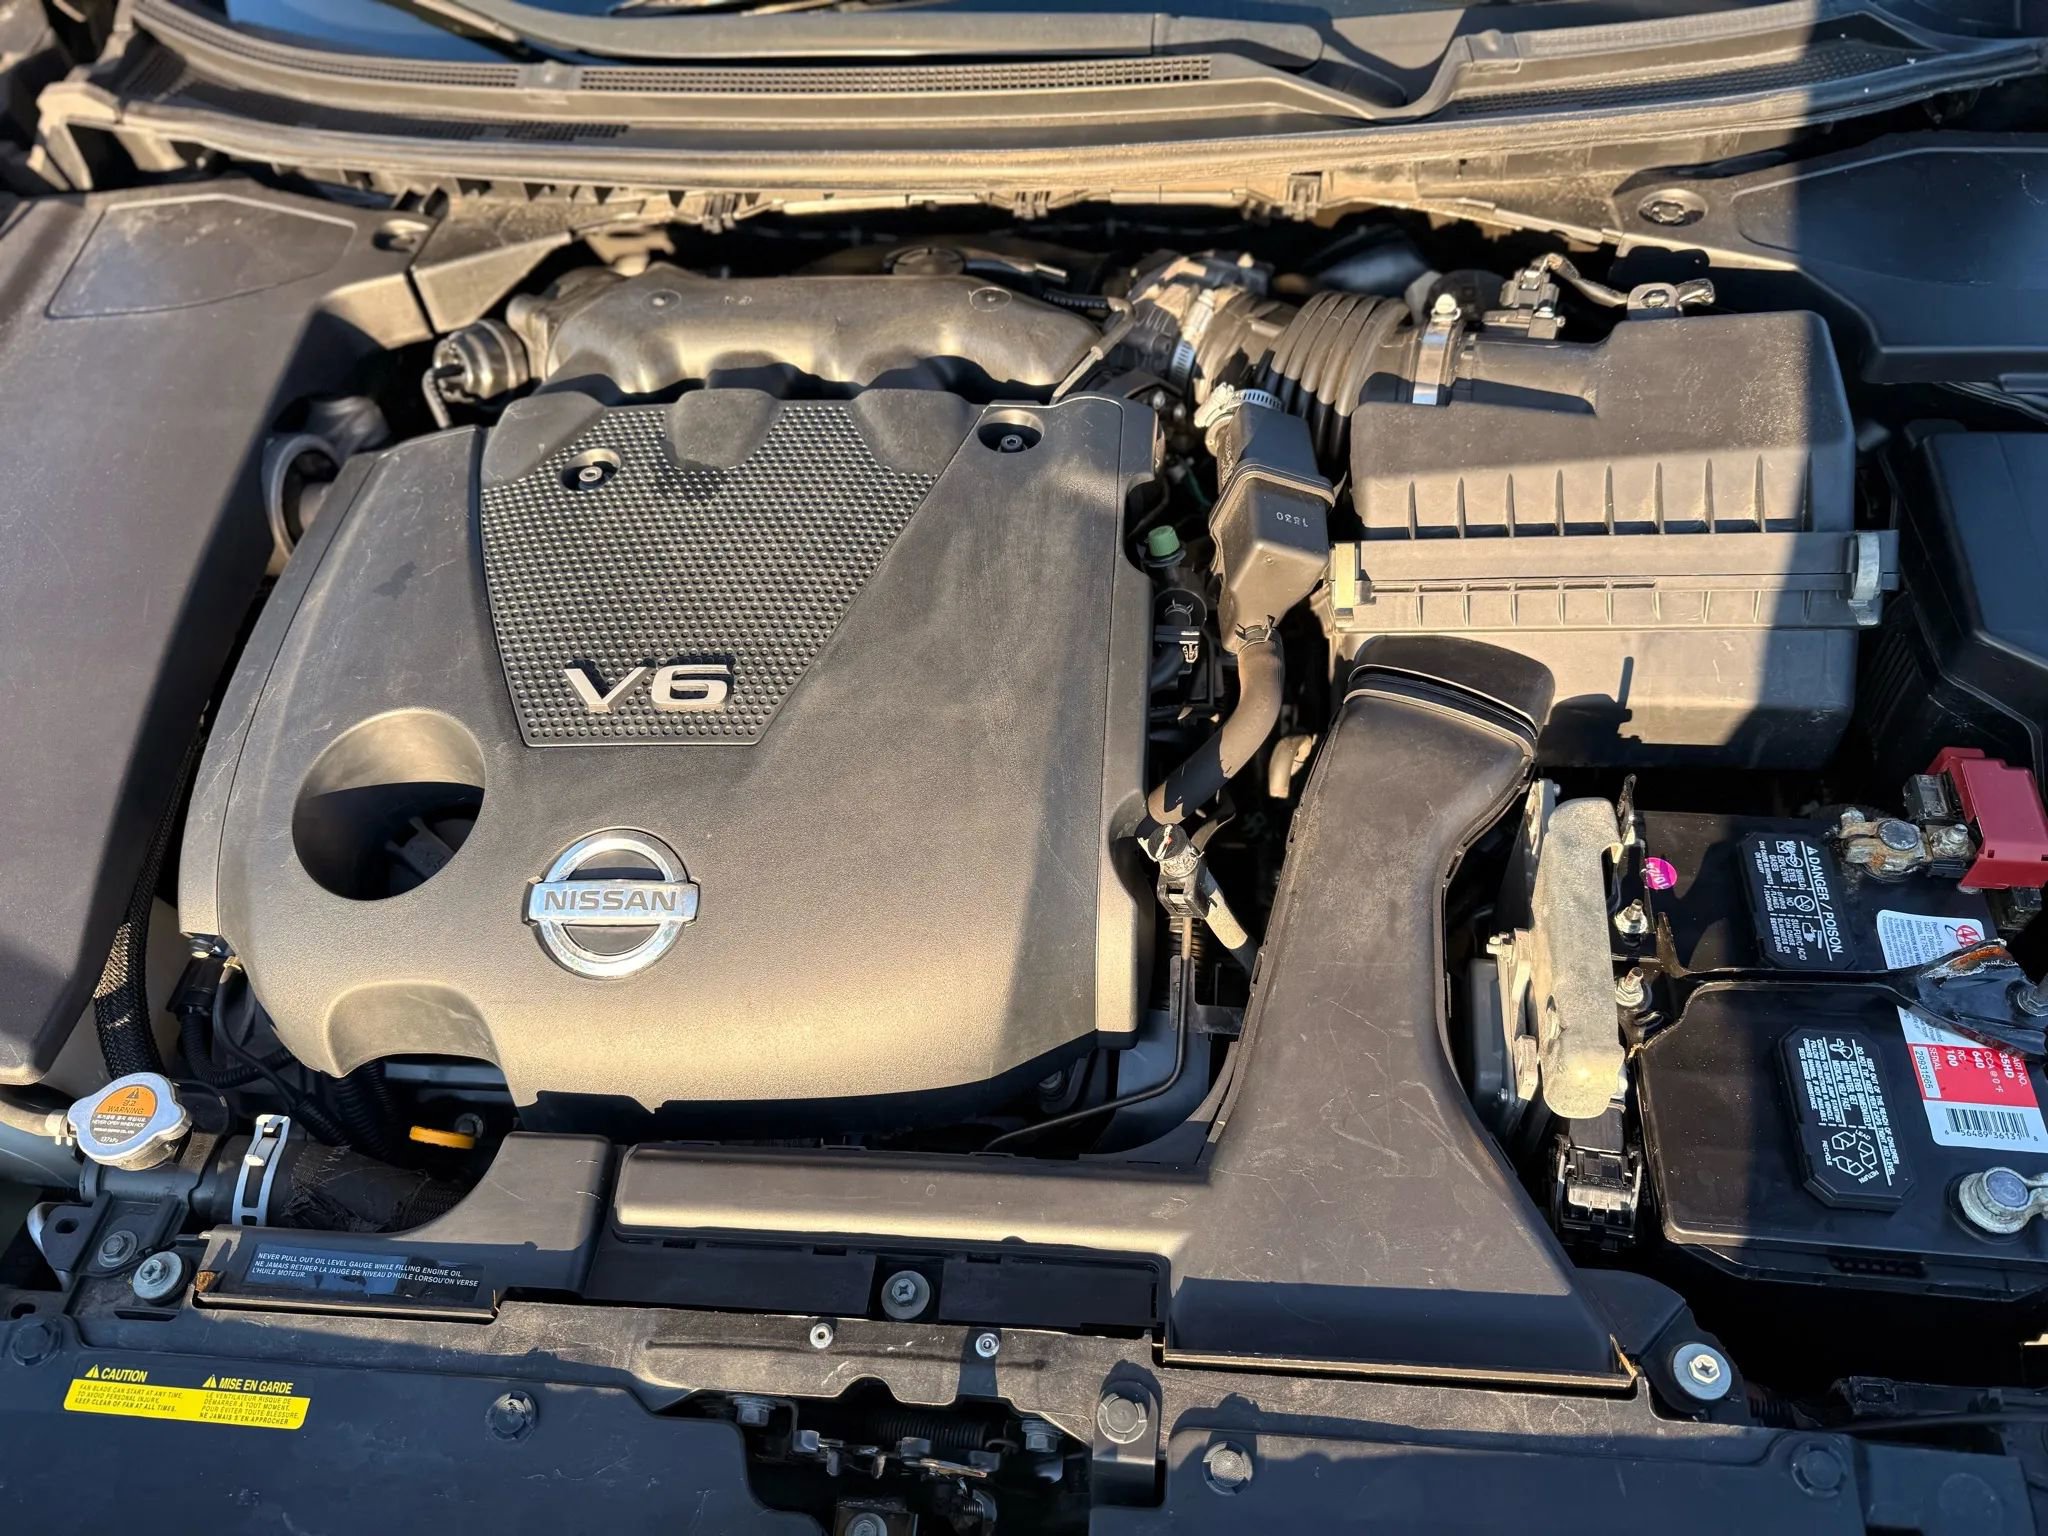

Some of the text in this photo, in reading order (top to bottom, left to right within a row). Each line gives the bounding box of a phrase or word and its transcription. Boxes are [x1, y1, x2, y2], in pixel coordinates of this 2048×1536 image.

[564, 663, 733, 712] V6
[1769, 855, 1779, 871] GASES
[1777, 855, 1790, 883] EXPLOSIVE
[1788, 868, 1797, 881] EYES
[1796, 869, 1806, 887] SHIELD
[544, 890, 677, 911] NISSAN
[1786, 897, 1794, 906] NO
[1809, 857, 1829, 900] DANGER
[1823, 912, 1842, 952] POISON
[1787, 930, 1795, 946] CAUSE
[1791, 919, 1803, 946] SULFURIC
[1929, 1048, 1941, 1070] SERIAL
[1947, 1050, 1958, 1066] 100
[1957, 1050, 1966, 1060] RC
[1972, 1051, 1985, 1068] 640
[1984, 1051, 1994, 1069] CCA
[1915, 1051, 1933, 1088] 29931565
[1999, 1053, 2014, 1078] 35HD
[2017, 1072, 2027, 1086] NO.
[107, 1105, 144, 1114] WARNING
[1855, 1129, 1871, 1141] LEAD
[1822, 1140, 1832, 1165] RECYCLE
[252, 1267, 276, 1275] L'HUILE
[394, 1264, 420, 1272] FILLING
[422, 1267, 449, 1275] ENGINE
[415, 1275, 454, 1284] LORSQU'ON
[101, 1368, 147, 1382] CAUTION
[219, 1378, 293, 1394] MISE EN GARDE
[106, 1393, 135, 1401] PERSONAL
[216, 1393, 256, 1401] VENTILATEUR
[251, 1416, 288, 1424] APPROCHER
